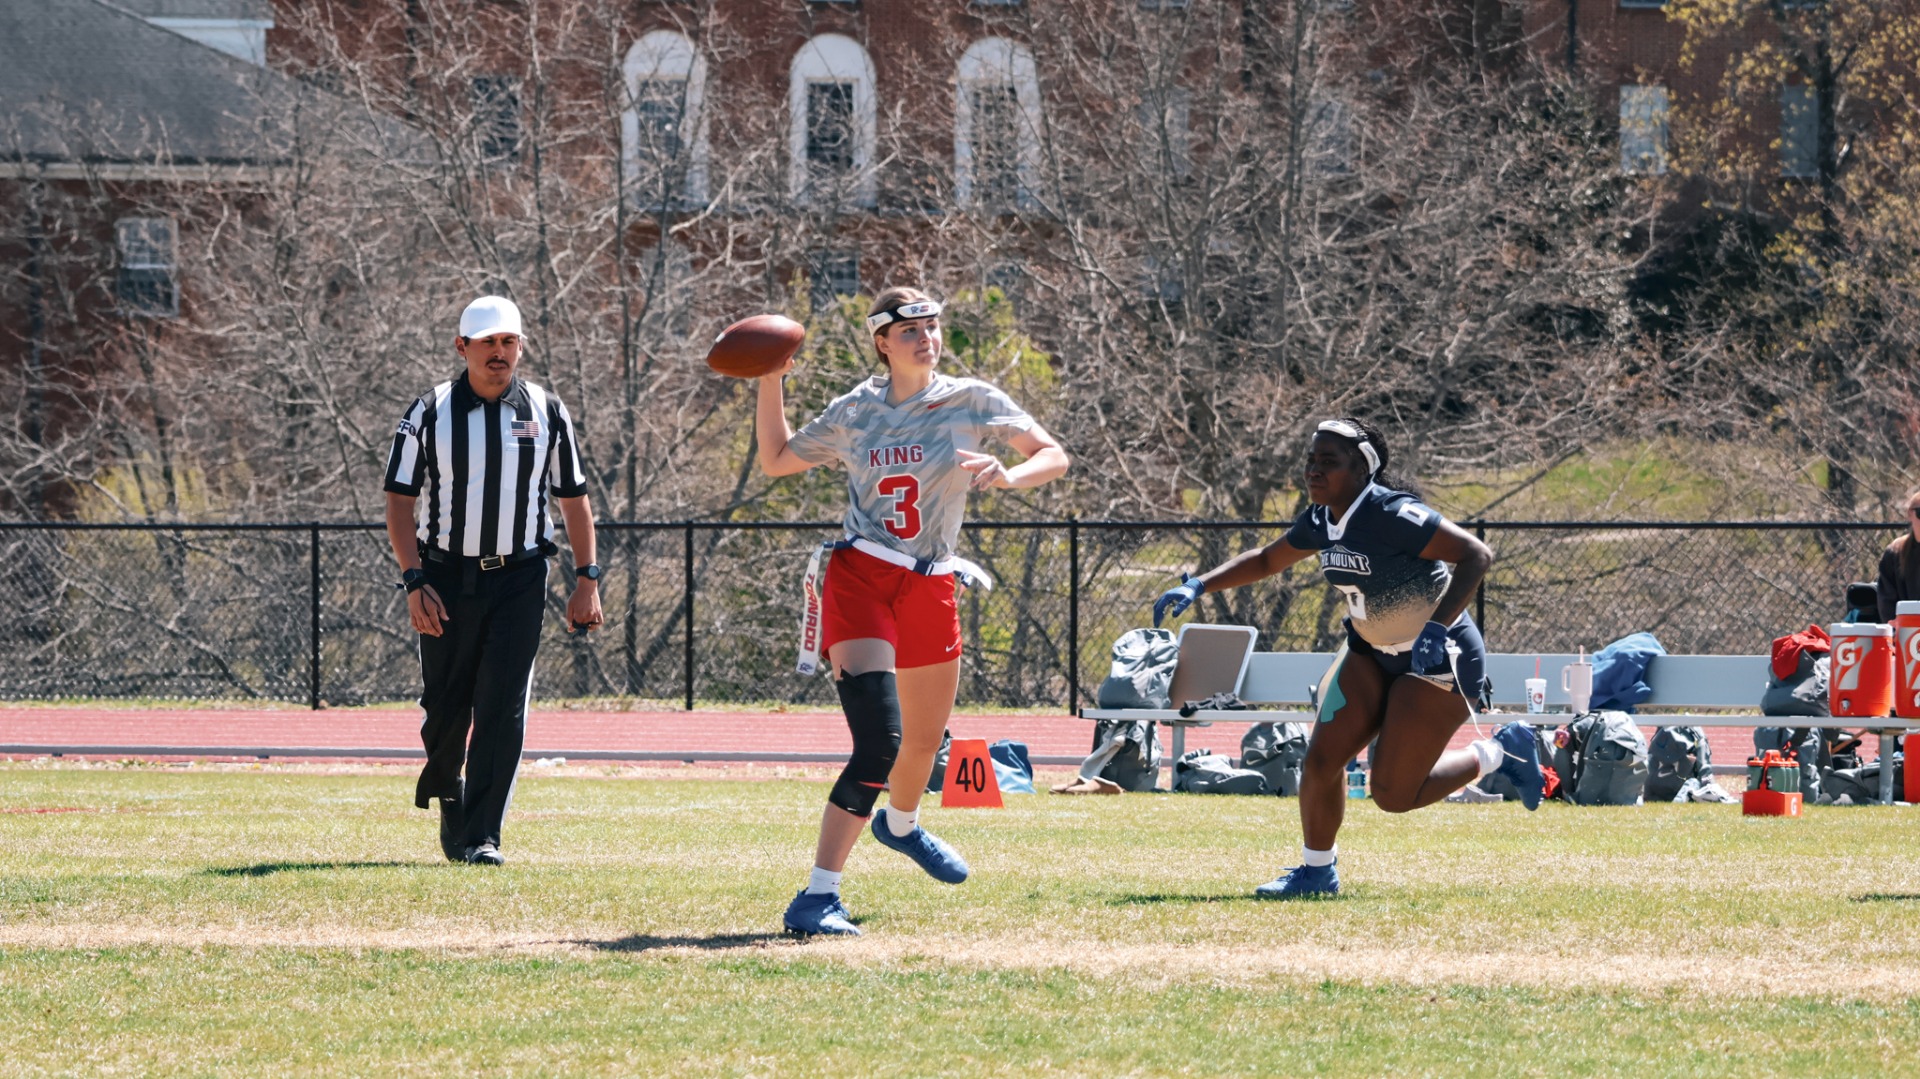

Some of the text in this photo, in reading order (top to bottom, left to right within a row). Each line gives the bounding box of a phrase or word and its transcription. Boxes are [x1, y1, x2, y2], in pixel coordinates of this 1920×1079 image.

[868, 444, 924, 468] KING
[877, 473, 923, 541] 3
[1397, 502, 1429, 527] 0
[1330, 552, 1367, 572] MOUNT
[804, 573, 819, 652] TORNADO
[1836, 641, 1856, 666] G
[955, 757, 986, 793] 40
[1790, 796, 1798, 816] G
